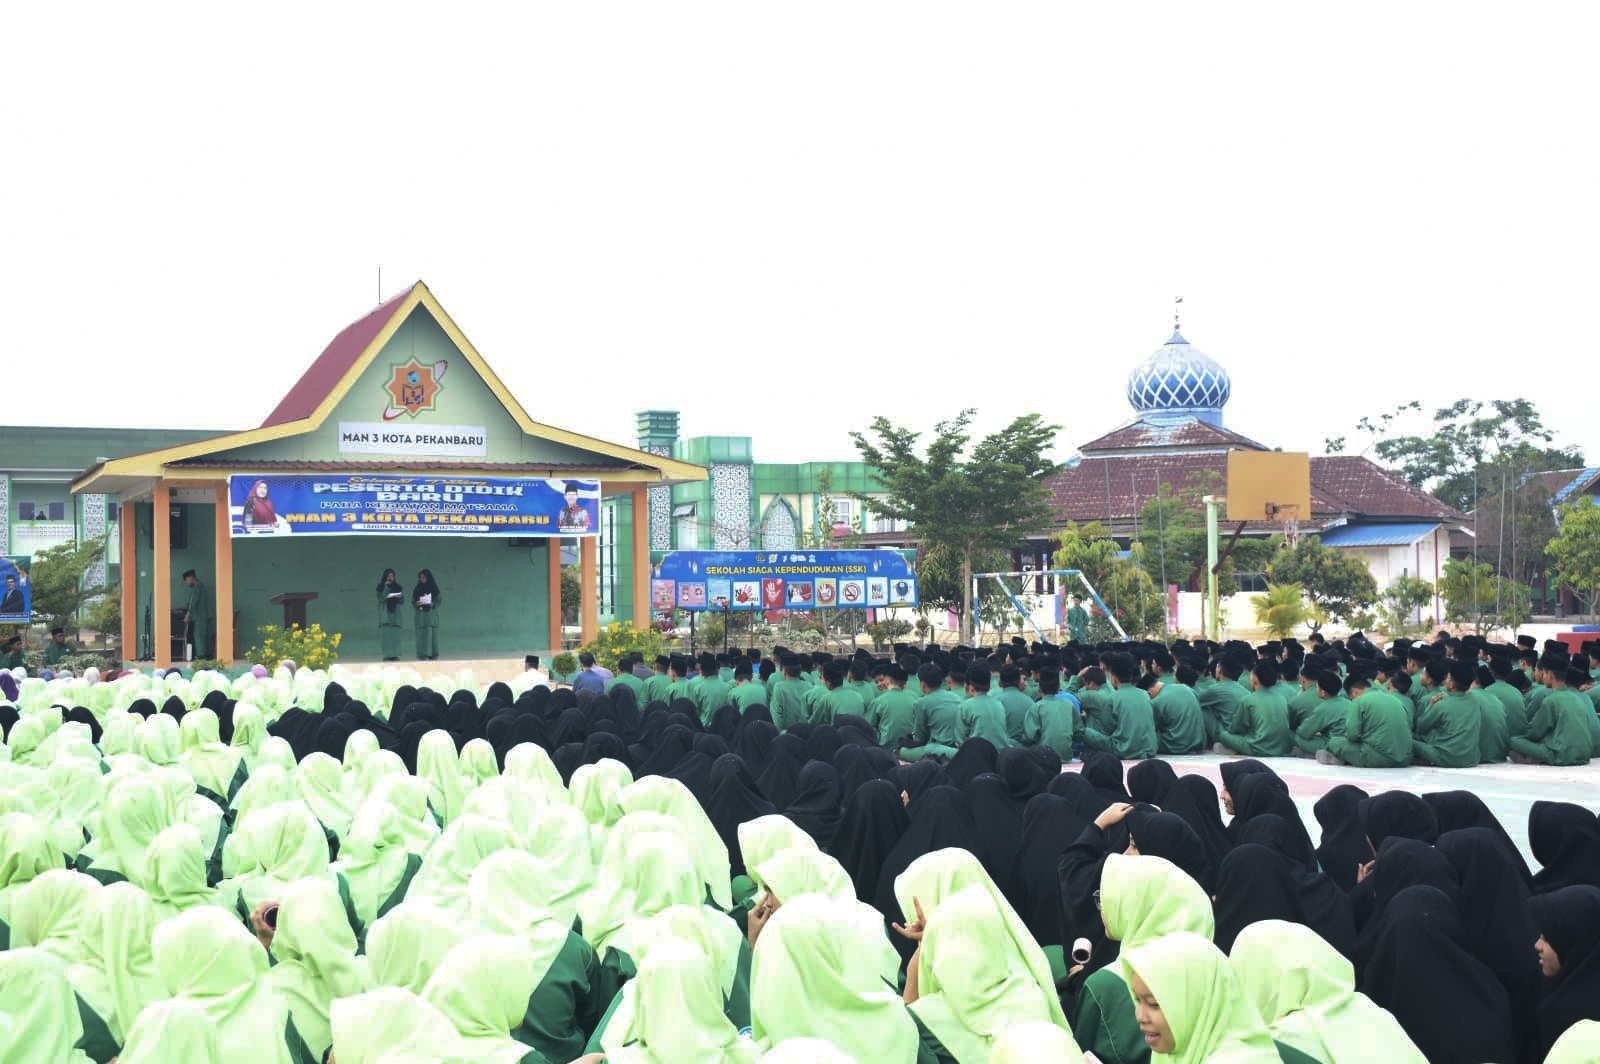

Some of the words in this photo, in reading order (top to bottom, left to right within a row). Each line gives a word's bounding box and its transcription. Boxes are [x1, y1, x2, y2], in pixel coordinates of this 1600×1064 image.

[343, 432, 369, 442] MAN
[372, 433, 379, 443] 3
[382, 433, 412, 444] KOTA
[415, 434, 484, 446] PEKANBARU
[313, 483, 435, 493] PESERTA
[444, 485, 524, 496] DIDIK
[377, 491, 463, 502] BARU
[320, 501, 362, 509] PADA
[444, 502, 518, 511] MATSAMA
[285, 513, 336, 523] MAN
[342, 512, 357, 523] 3
[362, 513, 420, 523] KOTA
[424, 513, 550, 524] PEKANBARU
[705, 566, 746, 575] SEKOLAH
[747, 566, 773, 574] SIAGA
[775, 565, 844, 574] KEPENDUDUKAN
[845, 565, 867, 574] (SSK)
